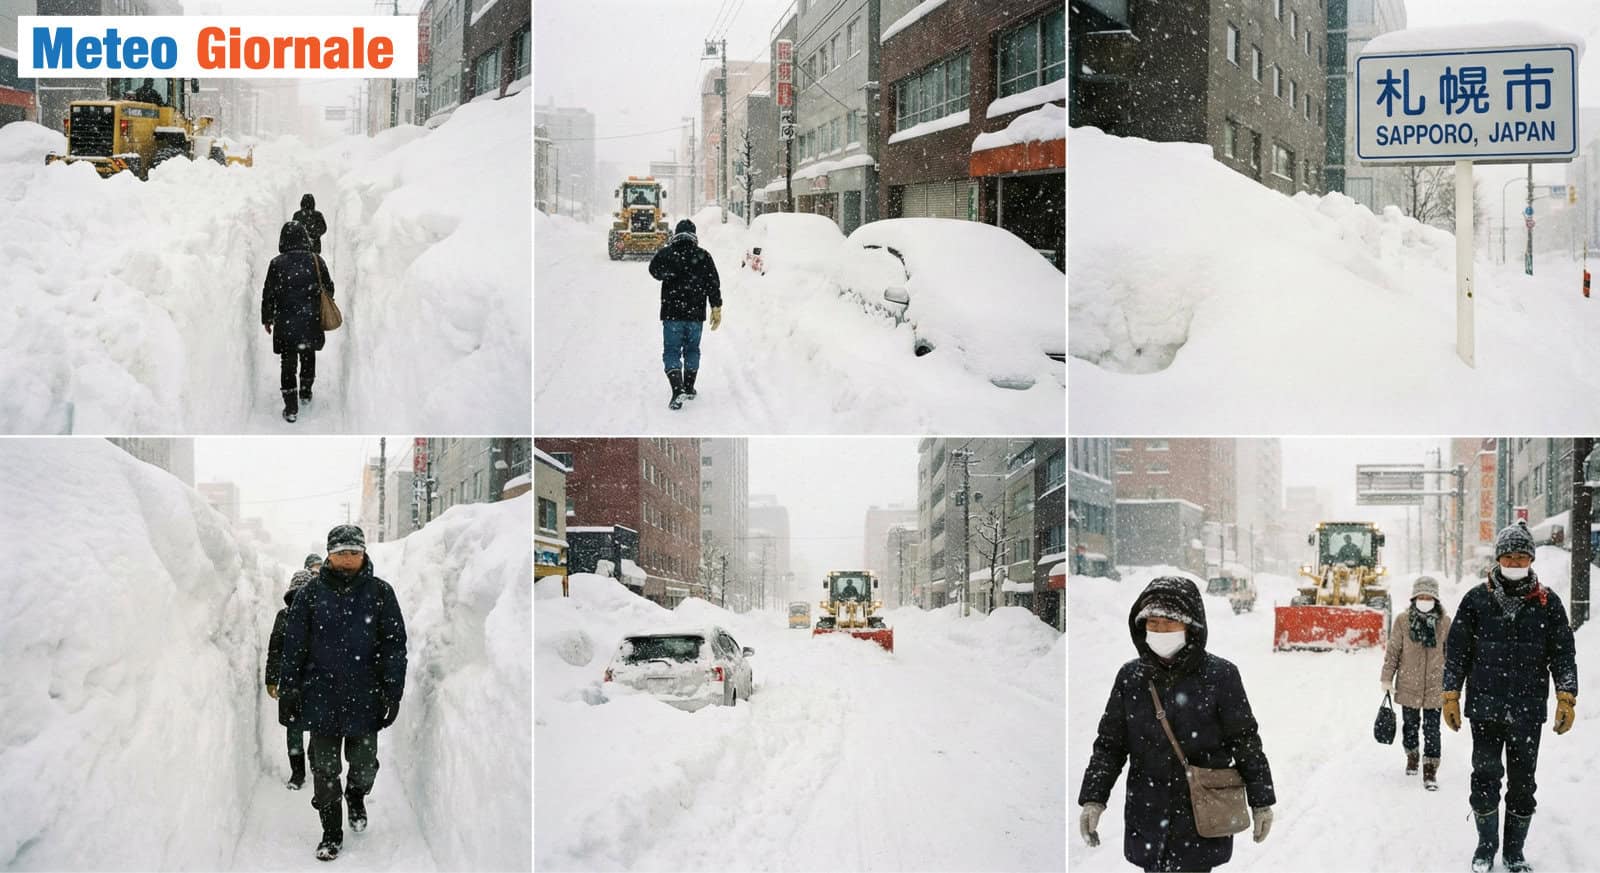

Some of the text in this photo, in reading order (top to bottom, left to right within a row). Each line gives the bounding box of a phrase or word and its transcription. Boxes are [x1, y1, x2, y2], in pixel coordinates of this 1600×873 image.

[1376, 63, 1554, 117] 札幌市
[1376, 120, 1556, 147] SAPPORO, JAPAN
